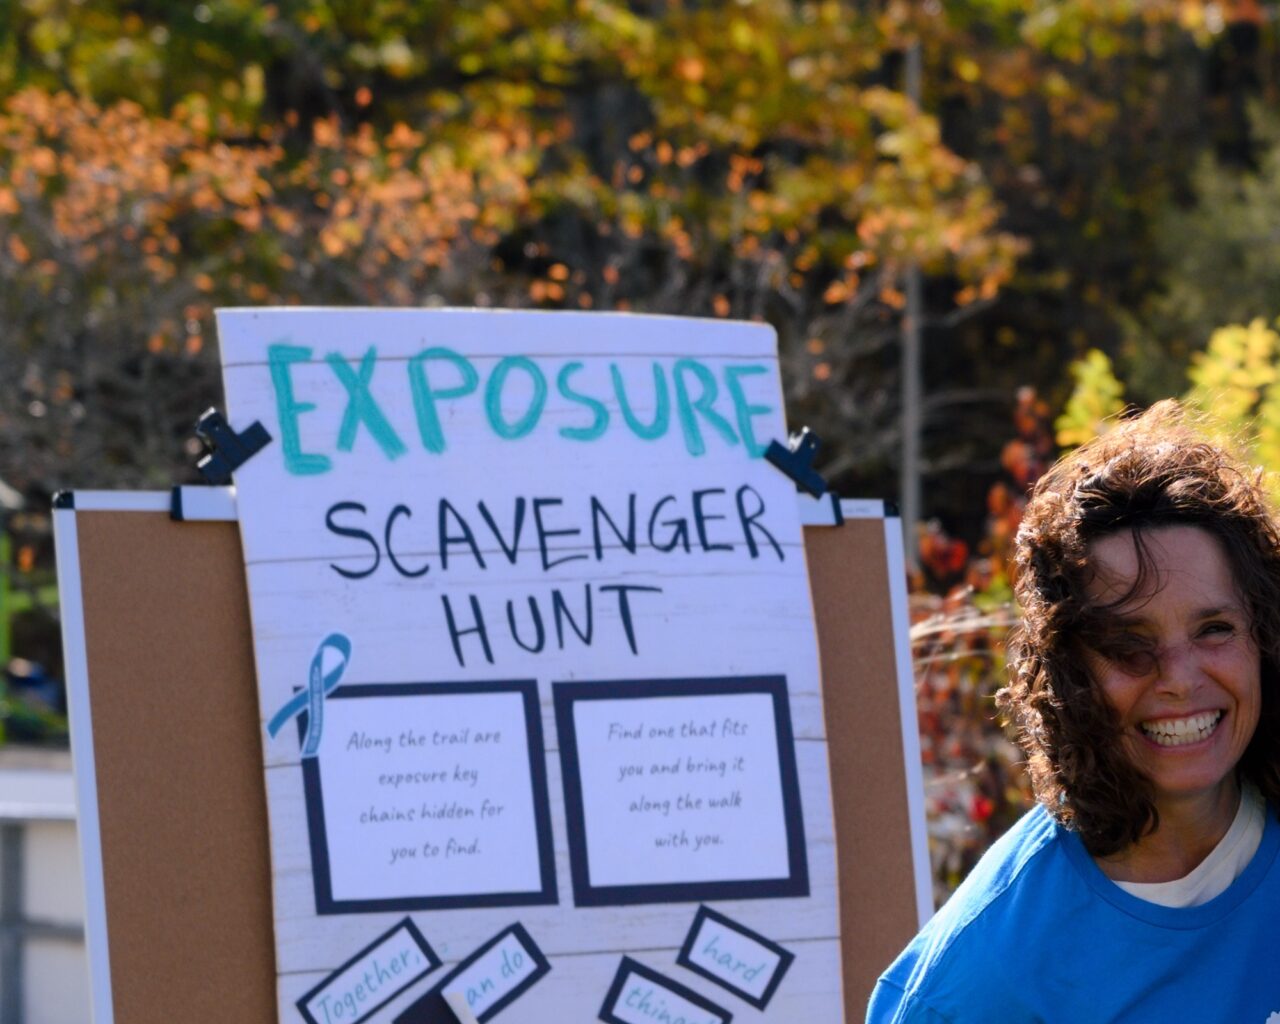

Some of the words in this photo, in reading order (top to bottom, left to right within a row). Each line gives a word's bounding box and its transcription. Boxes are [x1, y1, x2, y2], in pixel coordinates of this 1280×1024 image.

[266, 342, 773, 476] EXPOSURE
[325, 484, 785, 579] SCAVENGER
[441, 583, 662, 667] HUNT
[346, 731, 393, 753] Along
[400, 730, 426, 747] the
[432, 729, 469, 744] trail
[475, 731, 501, 744] are
[607, 722, 643, 740] Find
[649, 726, 675, 738] one
[680, 721, 716, 737] that
[722, 718, 748, 737] fits
[378, 770, 447, 788] exposure
[453, 764, 479, 786] key
[618, 763, 643, 782] you
[650, 758, 680, 775] and
[686, 757, 727, 778] bring
[733, 757, 745, 772] it
[359, 806, 415, 824] chains
[421, 802, 474, 819] hidden
[480, 799, 504, 819] for
[629, 796, 671, 816] along
[677, 794, 702, 810] the
[708, 791, 742, 808] walk
[389, 847, 417, 864] you
[423, 843, 440, 857] to
[445, 838, 481, 859] find.
[655, 830, 689, 848] with
[694, 835, 723, 851] you.
[500, 949, 524, 979] do
[702, 935, 768, 982] hard
